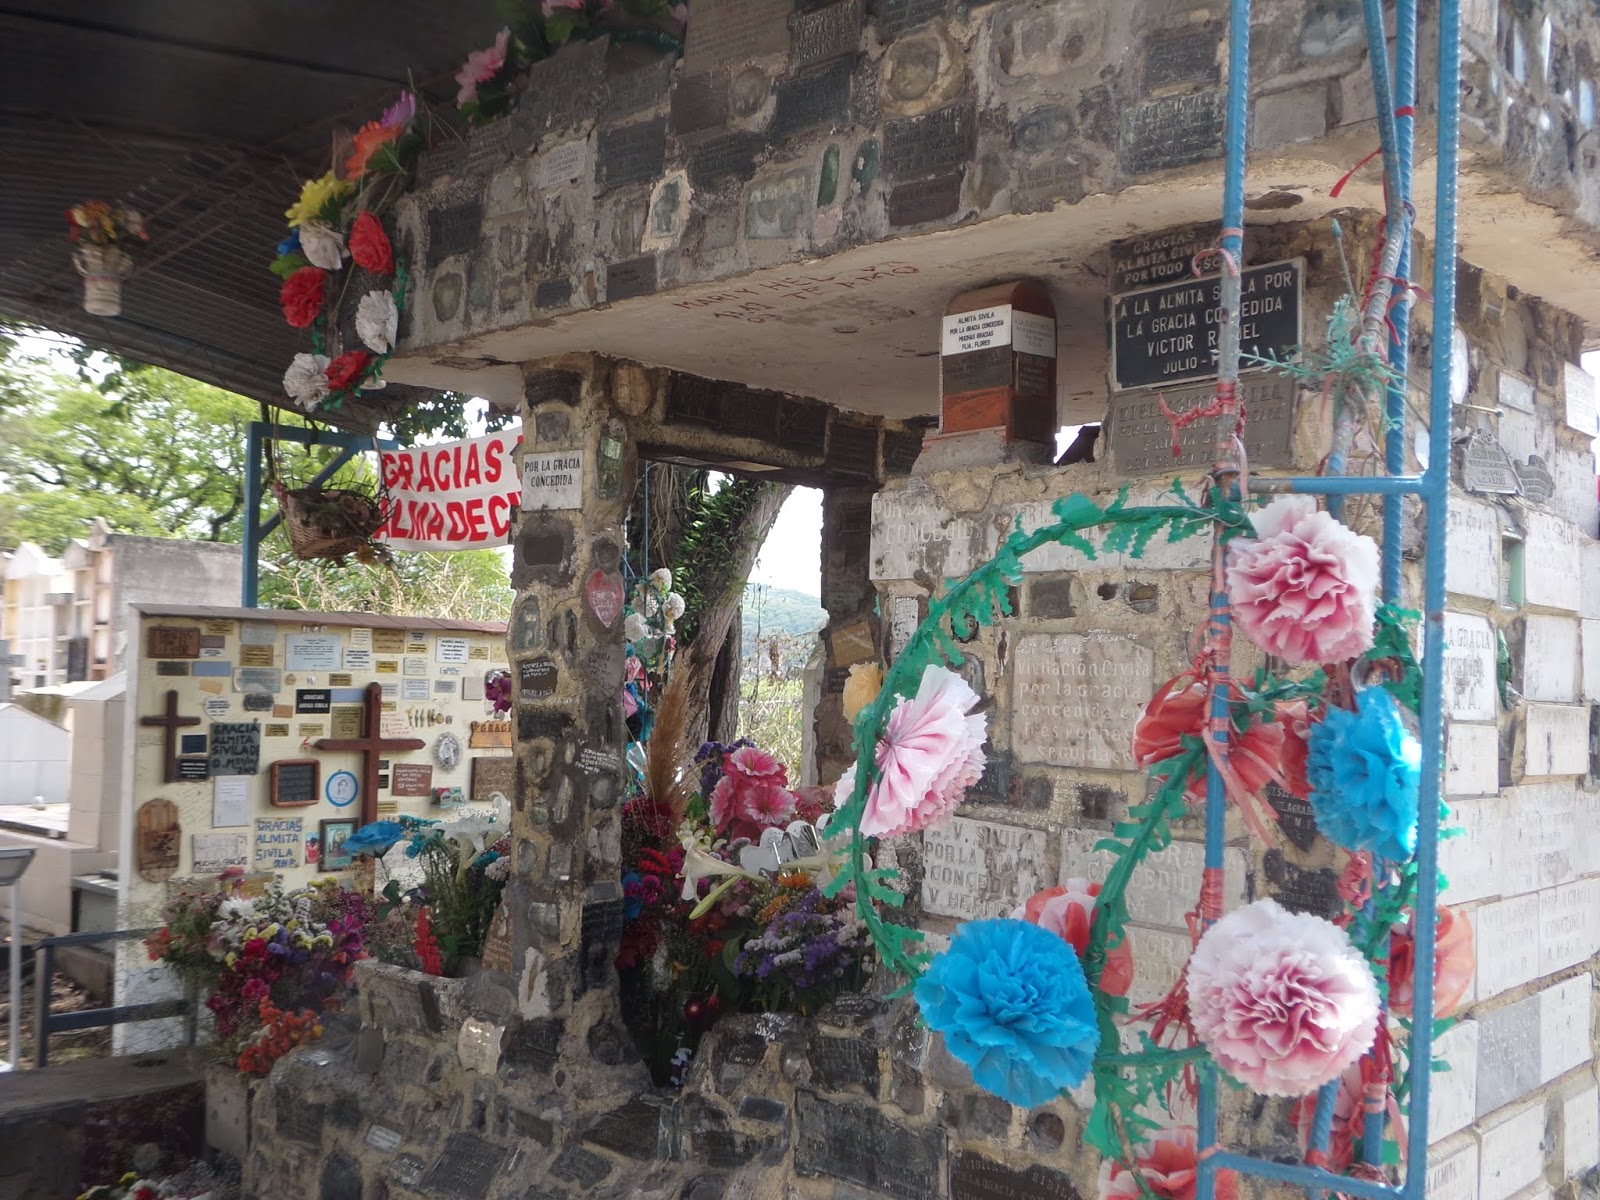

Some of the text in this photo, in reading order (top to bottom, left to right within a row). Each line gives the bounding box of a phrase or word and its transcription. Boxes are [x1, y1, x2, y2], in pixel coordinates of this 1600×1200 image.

[1134, 231, 1197, 254] GRACIAS
[1125, 271, 1149, 284] POR
[1151, 261, 1184, 278] TODO
[1120, 304, 1128, 318] A
[1133, 301, 1151, 316] LA
[1158, 288, 1205, 310] ALMITA
[1264, 271, 1293, 290] POR
[957, 313, 977, 325] ALMITA
[1126, 321, 1143, 338] LA
[1151, 312, 1197, 334] GRACIA
[949, 326, 958, 335] POR
[959, 325, 965, 334] LA
[966, 323, 981, 333] GRACIA
[958, 330, 994, 343] MUCHAS GRACIAS
[974, 339, 991, 348] FLORES
[1147, 333, 1195, 357] VICTOR
[1162, 355, 1199, 375] JULIO
[382, 439, 504, 492] GRACIAS
[524, 456, 580, 473] POR LA GRACIA
[530, 473, 573, 487] CONCEDIDA
[1056, 680, 1072, 697] la
[257, 820, 303, 832] GRACIAS
[256, 833, 299, 844] ALMITA
[255, 848, 293, 861] SIVILA
[924, 840, 955, 864] POR
[958, 846, 978, 865] LA
